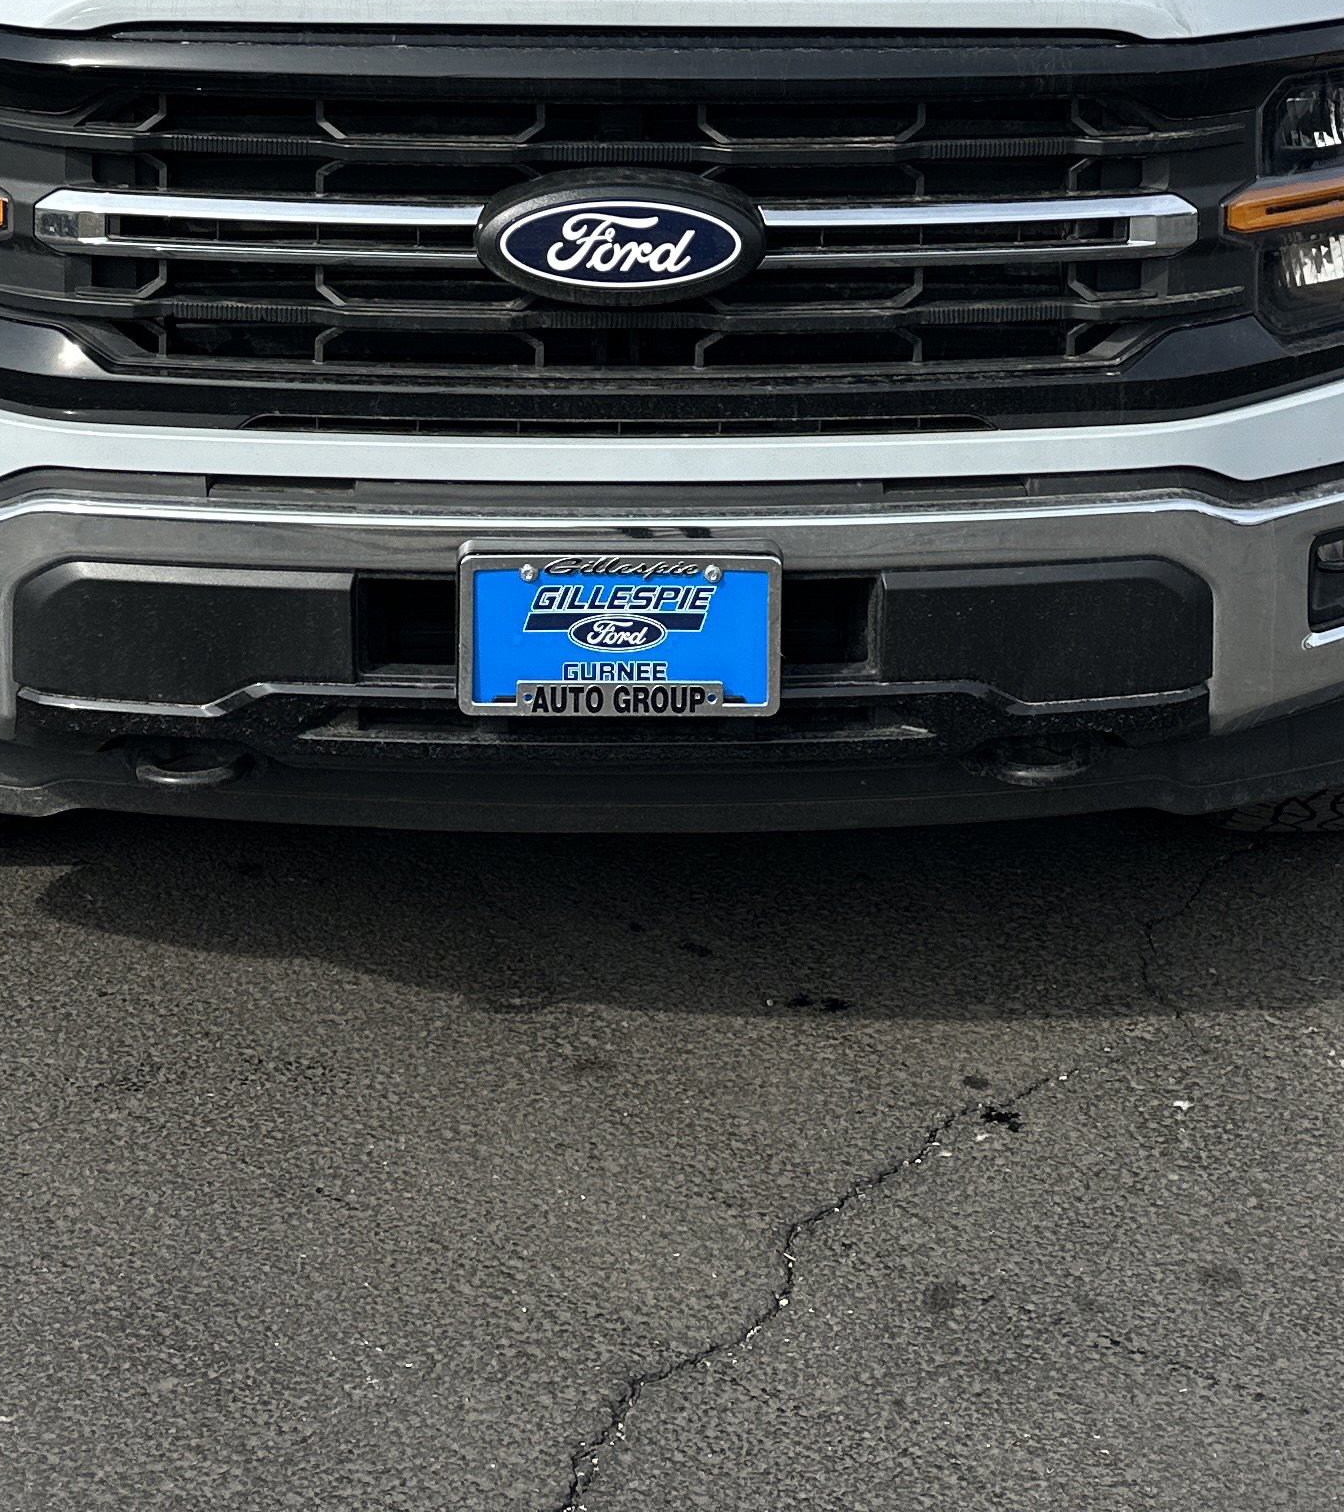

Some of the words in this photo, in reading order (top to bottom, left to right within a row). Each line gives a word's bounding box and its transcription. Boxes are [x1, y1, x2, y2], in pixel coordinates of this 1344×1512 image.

[547, 213, 696, 273] Ford
[543, 555, 701, 581] Gillespie
[532, 584, 717, 612] GILLESPIE
[586, 619, 648, 646] Ford
[562, 661, 669, 681] GURNEE
[531, 685, 605, 714] AUTO
[612, 685, 707, 714] GROUP
